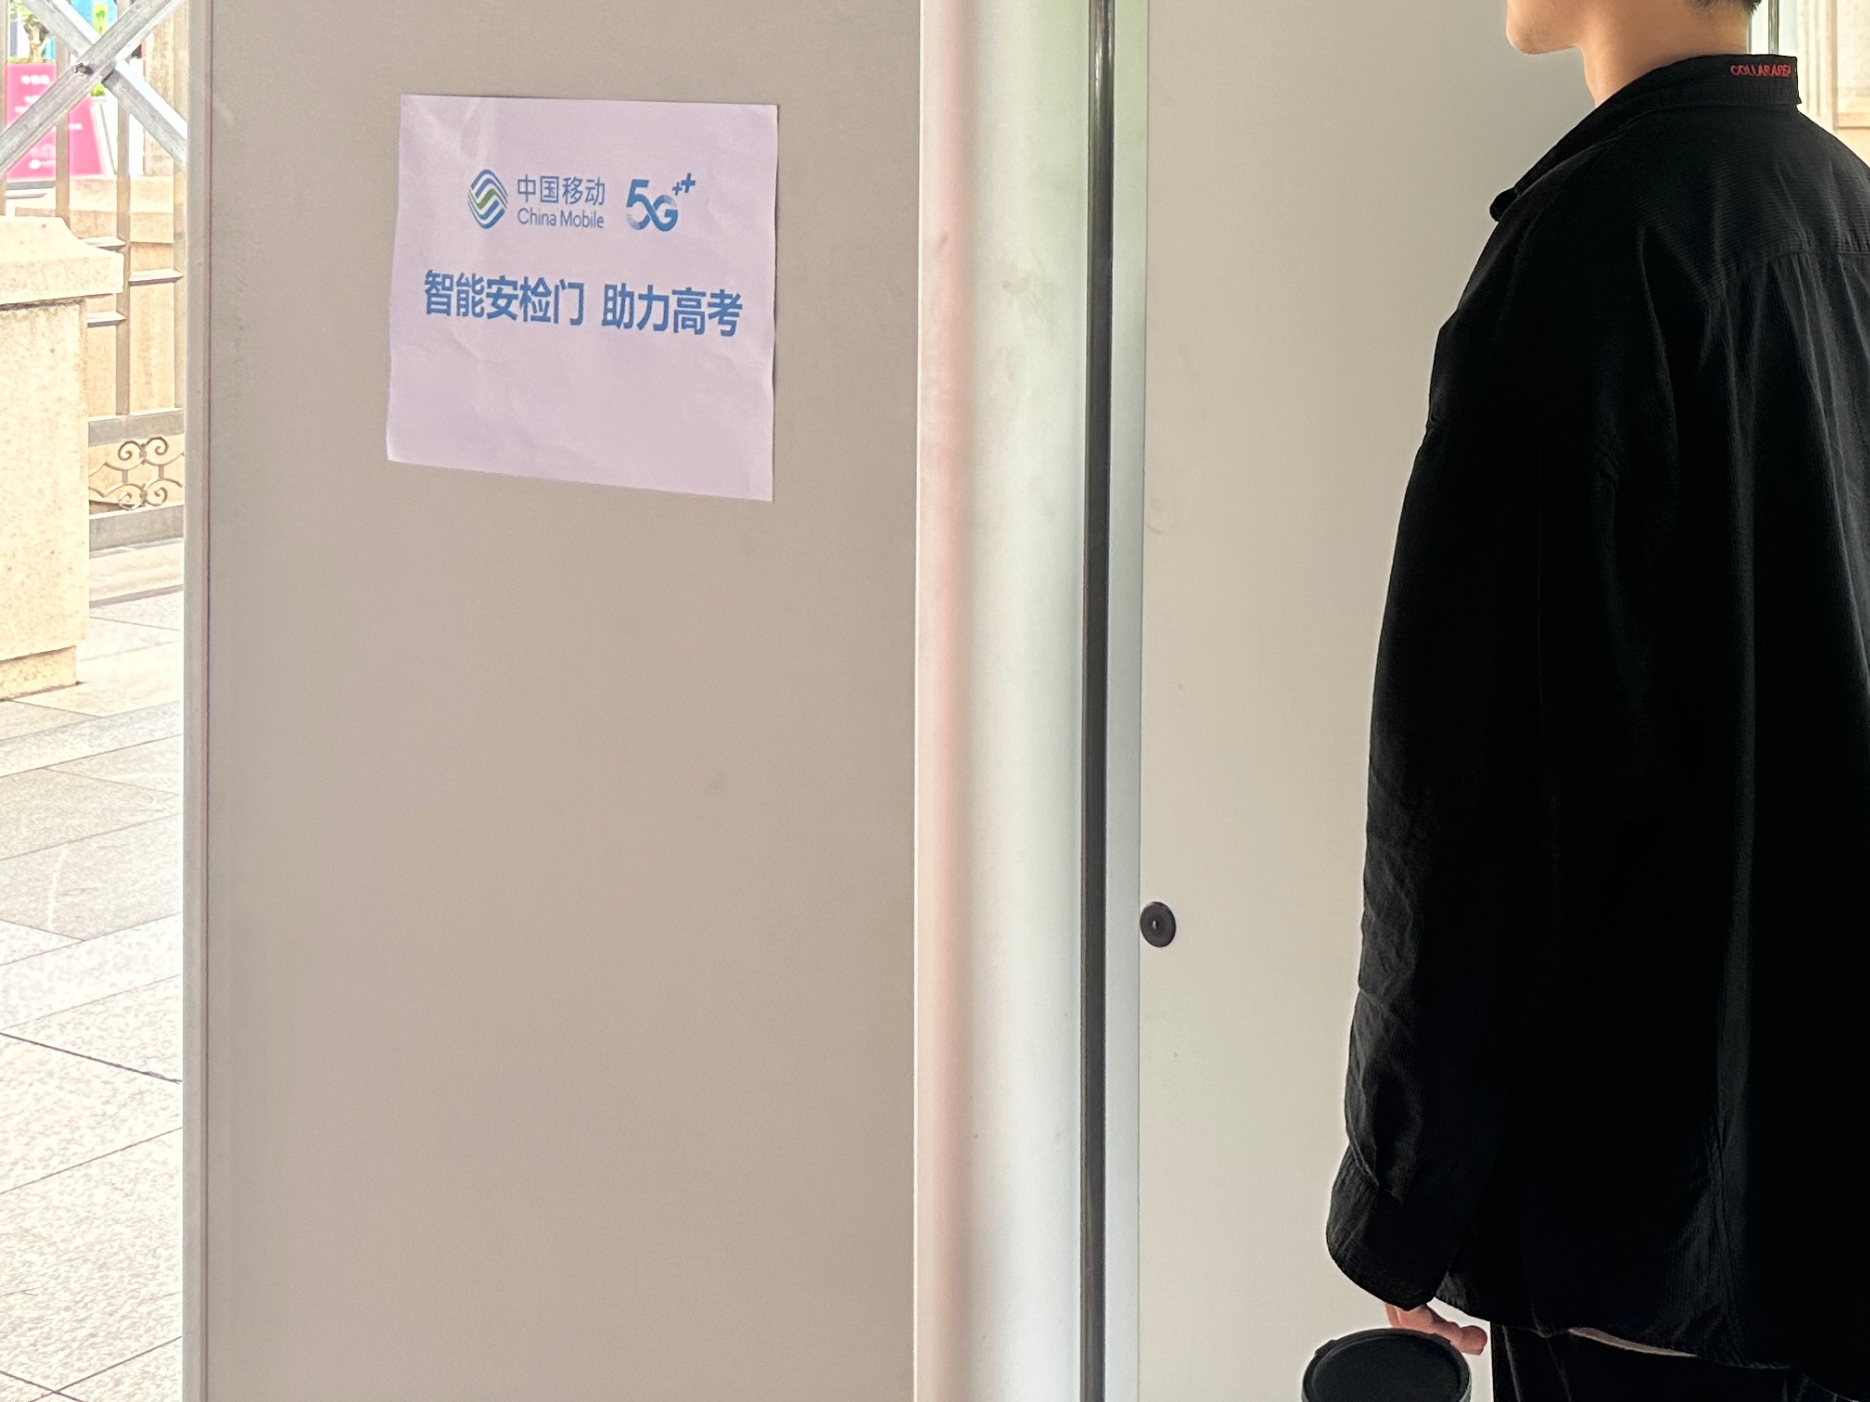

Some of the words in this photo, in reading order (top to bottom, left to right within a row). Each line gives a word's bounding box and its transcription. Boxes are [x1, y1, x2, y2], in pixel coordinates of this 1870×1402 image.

[517, 174, 606, 207] 中国移动
[517, 207, 558, 227] China
[560, 210, 605, 230] Mobile
[425, 269, 586, 327] 智能安检门
[602, 282, 744, 339] 助力高考
